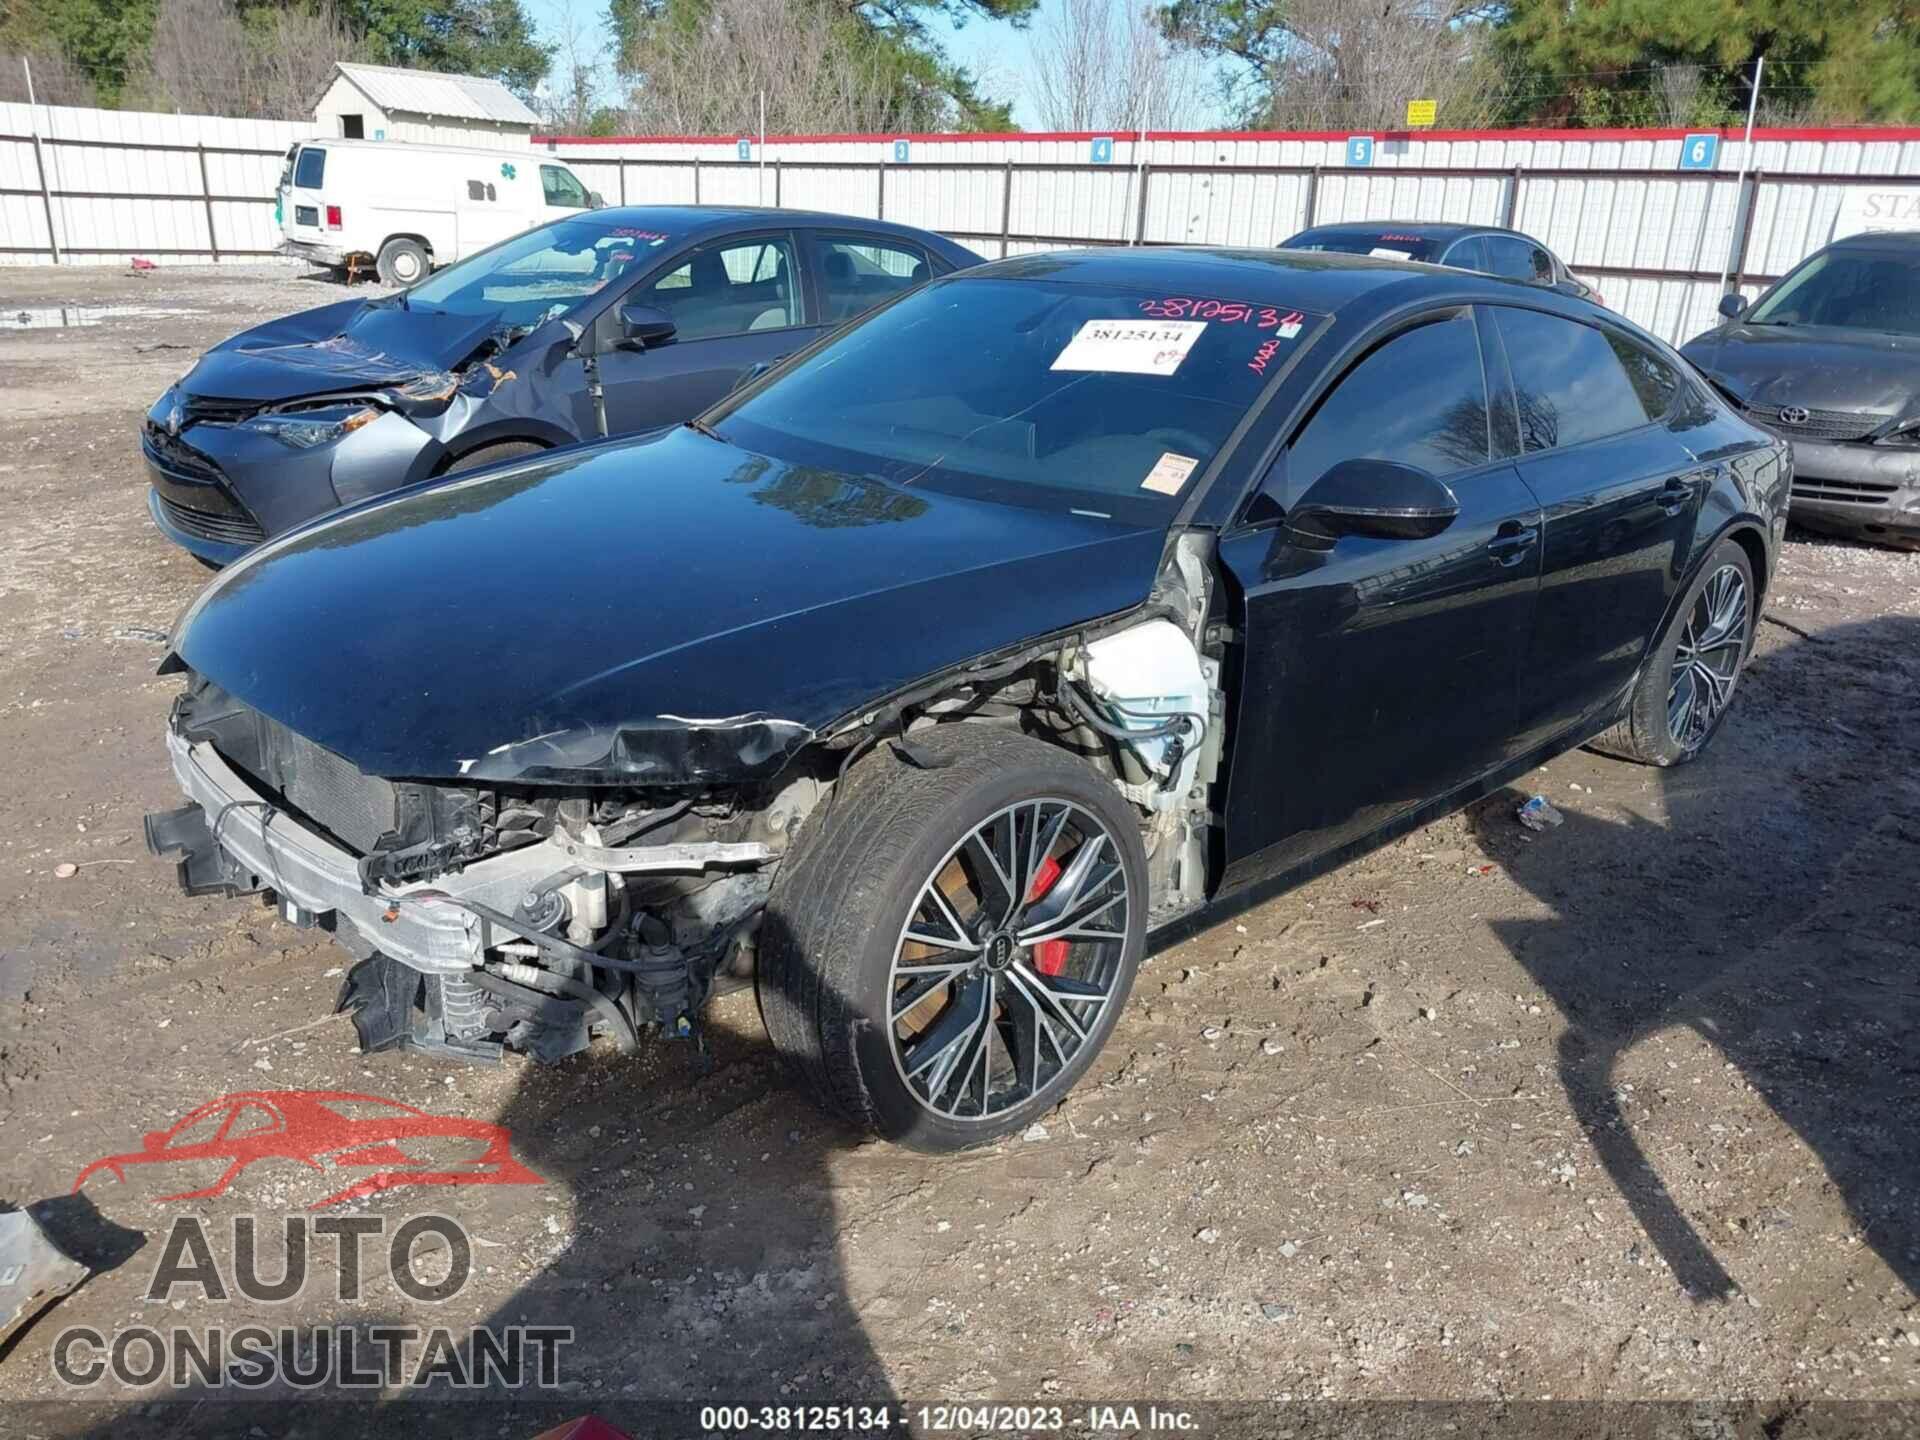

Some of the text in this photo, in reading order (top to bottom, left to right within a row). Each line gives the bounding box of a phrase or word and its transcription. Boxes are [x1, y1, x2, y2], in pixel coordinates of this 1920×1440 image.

[1355, 142, 1365, 160] 5
[1692, 141, 1706, 162] 6
[1139, 298, 1303, 329] 38125134
[1085, 329, 1184, 342] 38125134
